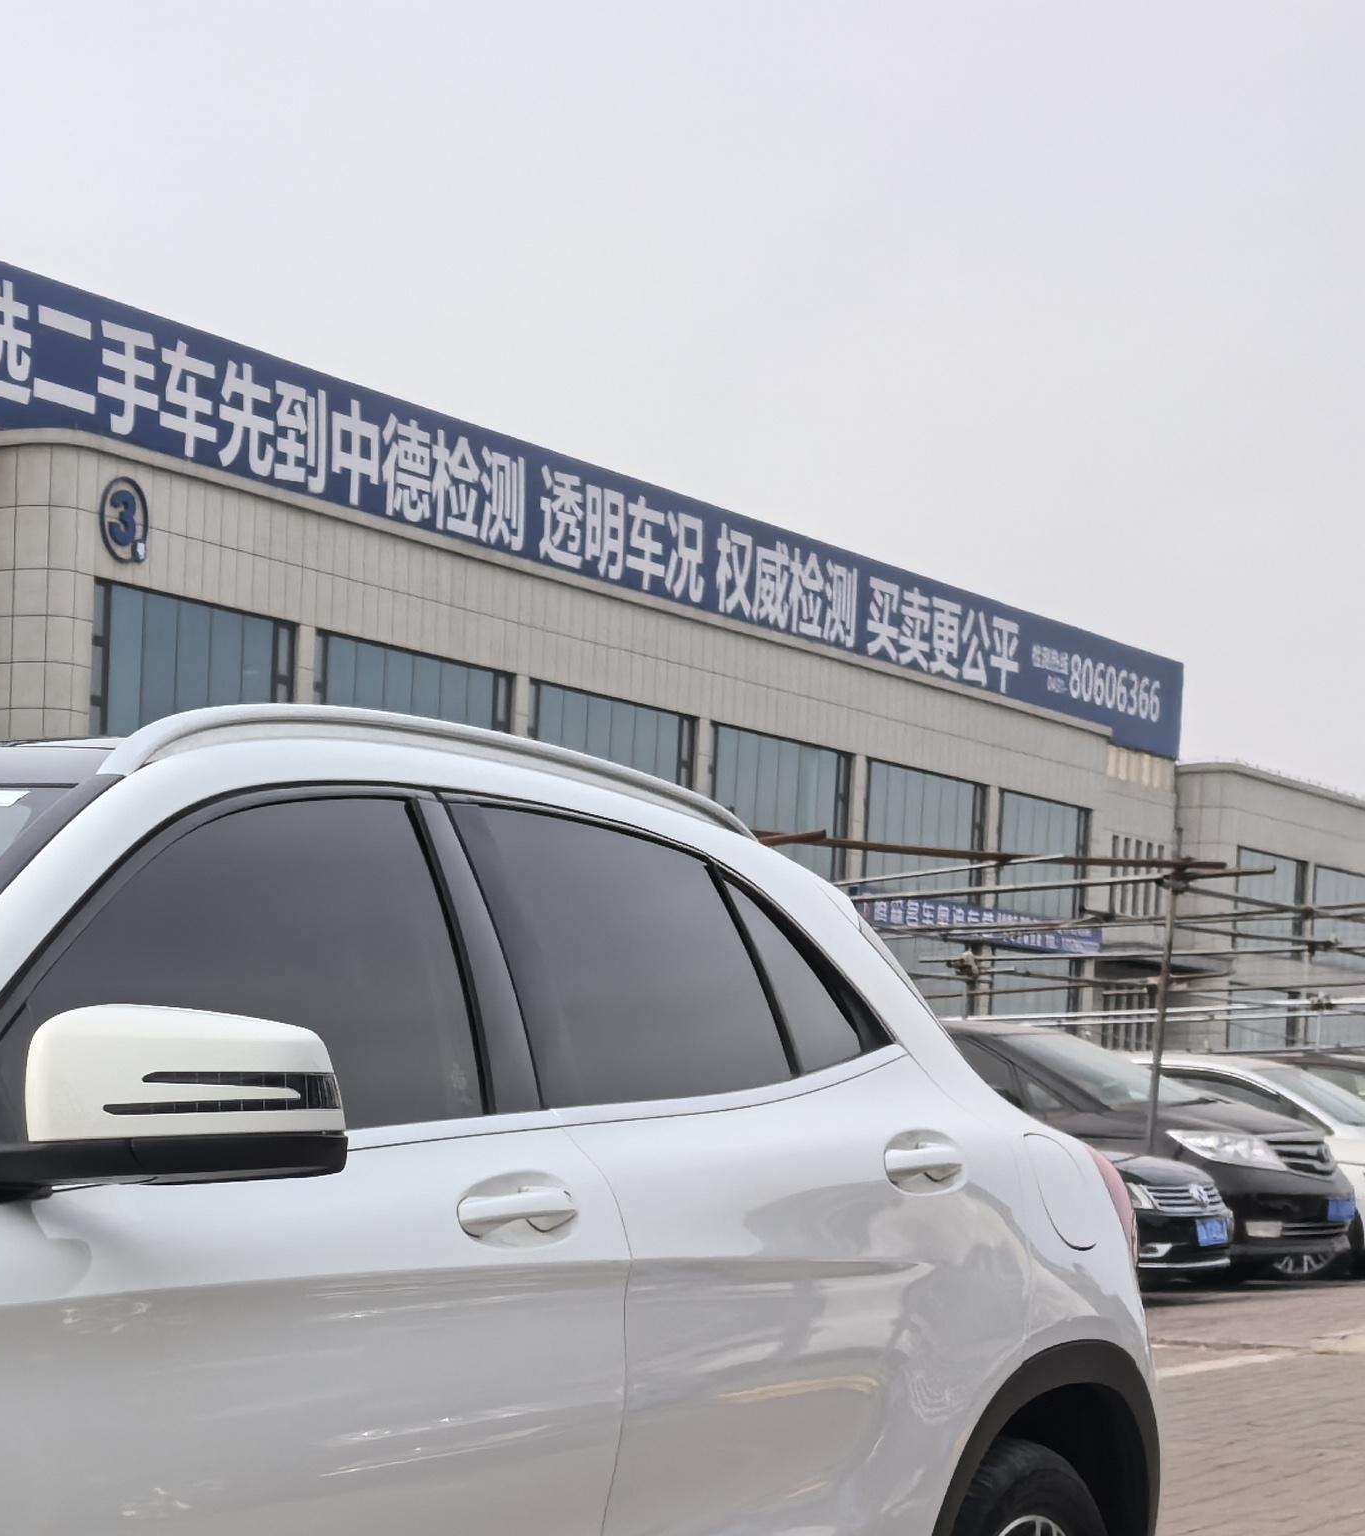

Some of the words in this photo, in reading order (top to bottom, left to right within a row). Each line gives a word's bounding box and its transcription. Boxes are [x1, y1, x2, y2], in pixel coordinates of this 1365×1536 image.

[539, 464, 705, 603] 透明车况
[716, 522, 859, 648] 权威检测
[867, 576, 1020, 693] 买卖更公平
[1069, 653, 1161, 723] 80606366
